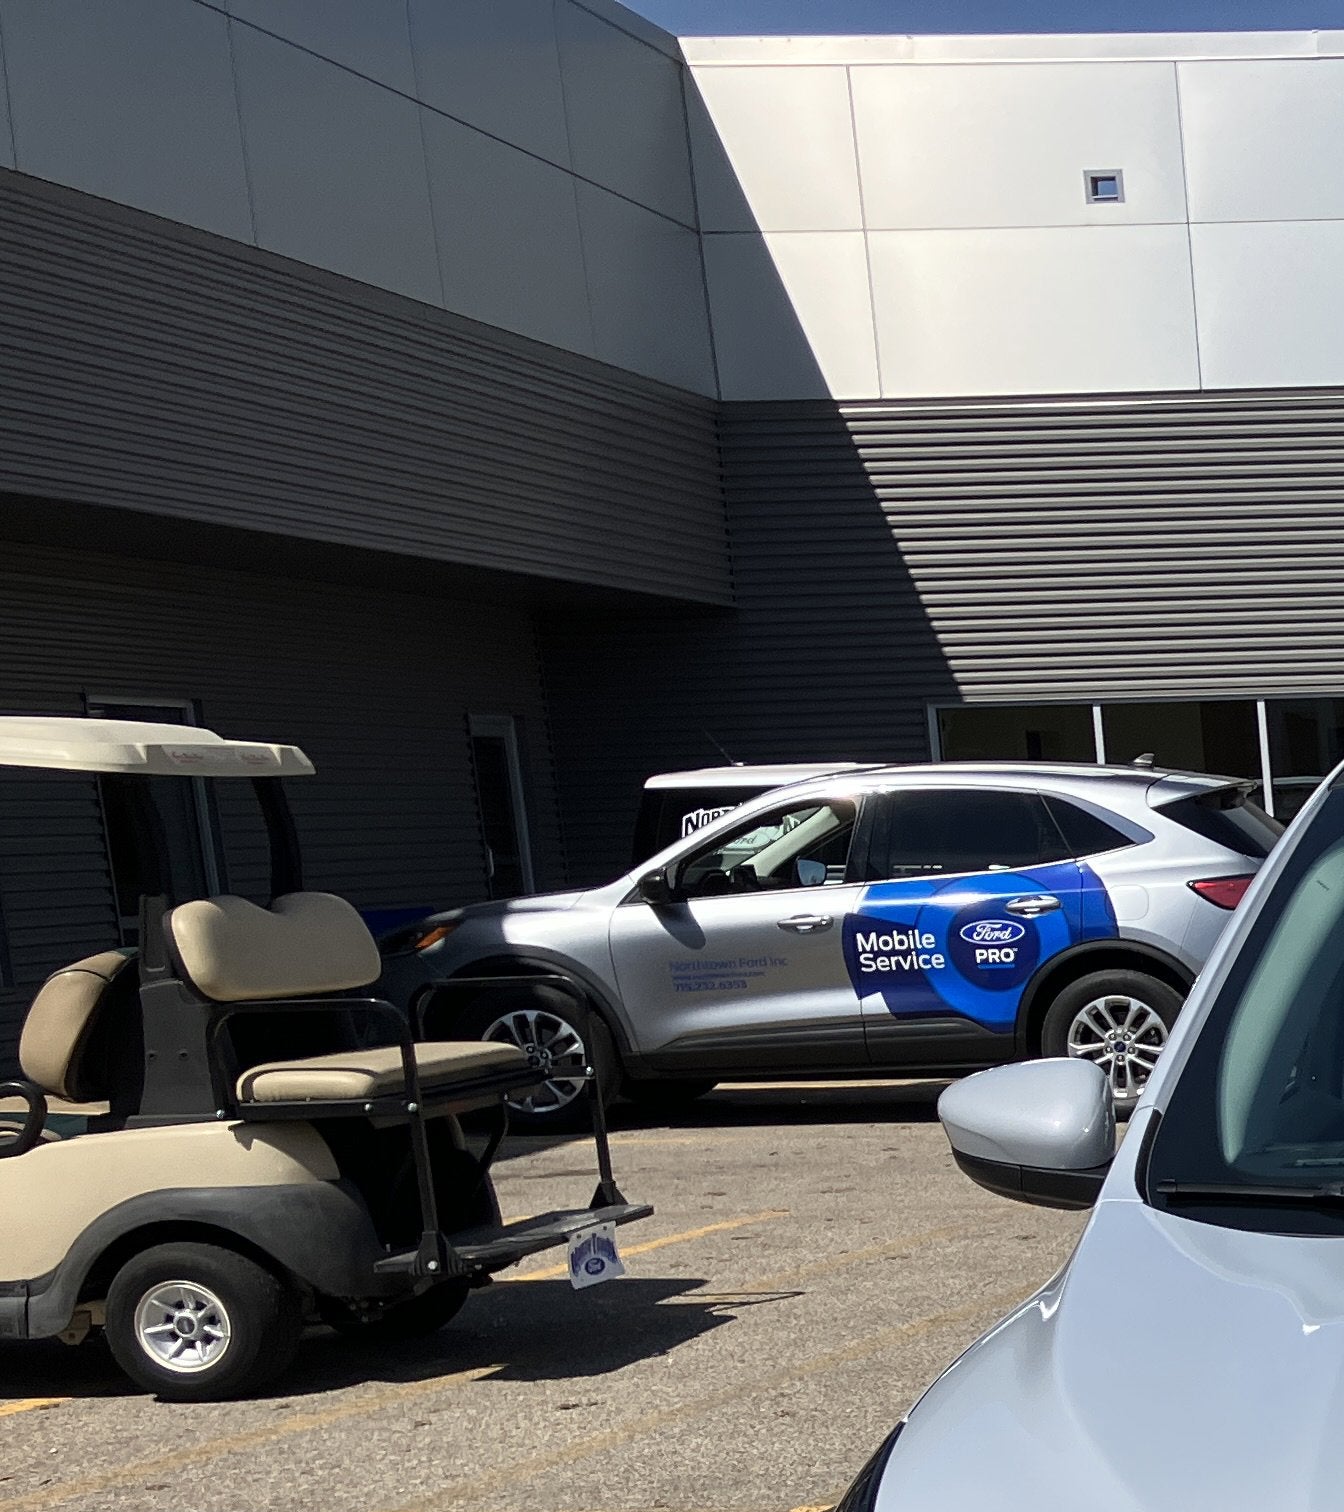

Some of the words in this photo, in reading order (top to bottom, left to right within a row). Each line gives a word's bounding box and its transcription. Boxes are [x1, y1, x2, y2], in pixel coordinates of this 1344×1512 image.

[856, 929, 935, 952] Mobile
[973, 923, 1012, 940] Ford
[859, 951, 945, 972] Service
